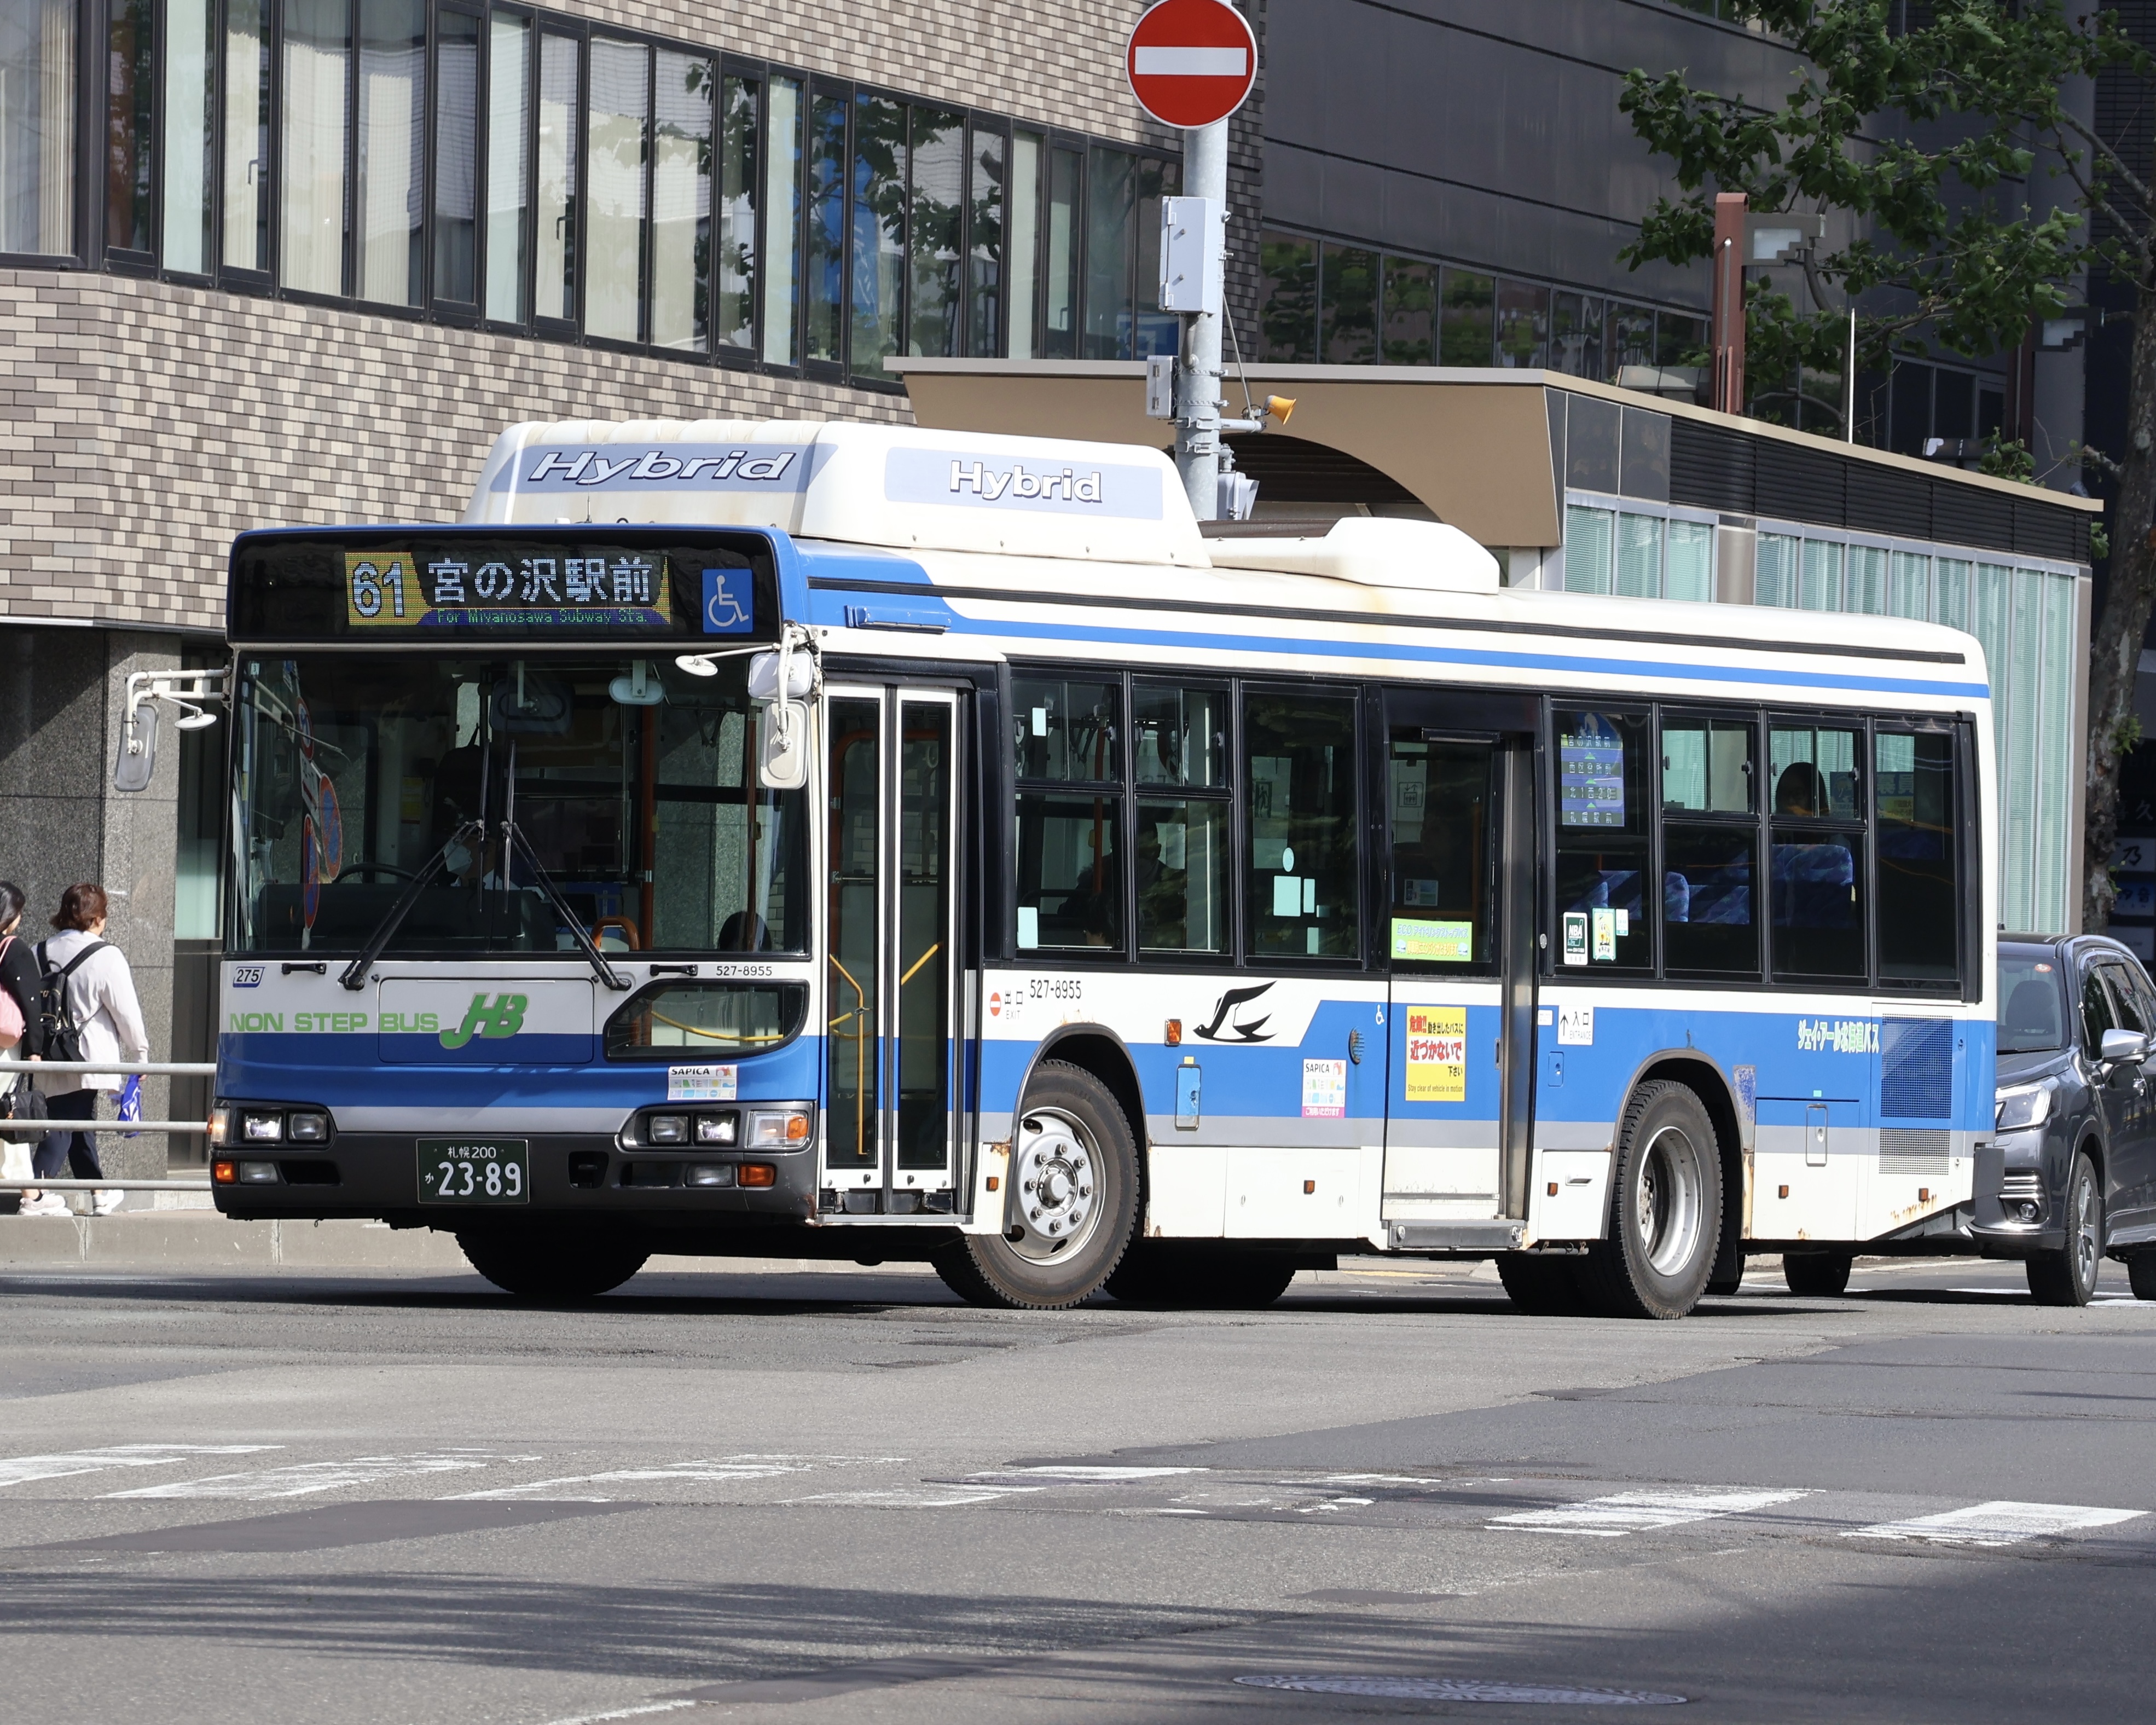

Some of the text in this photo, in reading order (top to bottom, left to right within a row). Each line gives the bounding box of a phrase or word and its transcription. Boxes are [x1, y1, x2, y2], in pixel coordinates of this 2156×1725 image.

[528, 450, 797, 485] Hybrid
[950, 460, 1103, 503] Hybrid
[352, 557, 653, 617] 61 宮の沢駅前
[437, 607, 460, 623] For
[1568, 924, 1583, 936] NBA
[236, 969, 260, 982] 275
[716, 965, 772, 976] 527-8955
[1029, 979, 1081, 999] 527-8955
[1004, 990, 1023, 1005] 出口
[230, 1012, 438, 1032] NON STEP BUS
[1006, 1010, 1021, 1020] EXIT
[1573, 1011, 1589, 1026] 入口
[1428, 1022, 1464, 1034] 動き出したバスに
[1569, 1031, 1591, 1040] ENTRANCE
[1410, 1039, 1462, 1061] 近づかないで
[1305, 1063, 1330, 1073] SAPICA
[1447, 1066, 1463, 1077] 下さい
[1407, 1084, 1417, 1093] Stay
[1417, 1084, 1427, 1092] clear
[425, 1161, 521, 1196] か 23-89
